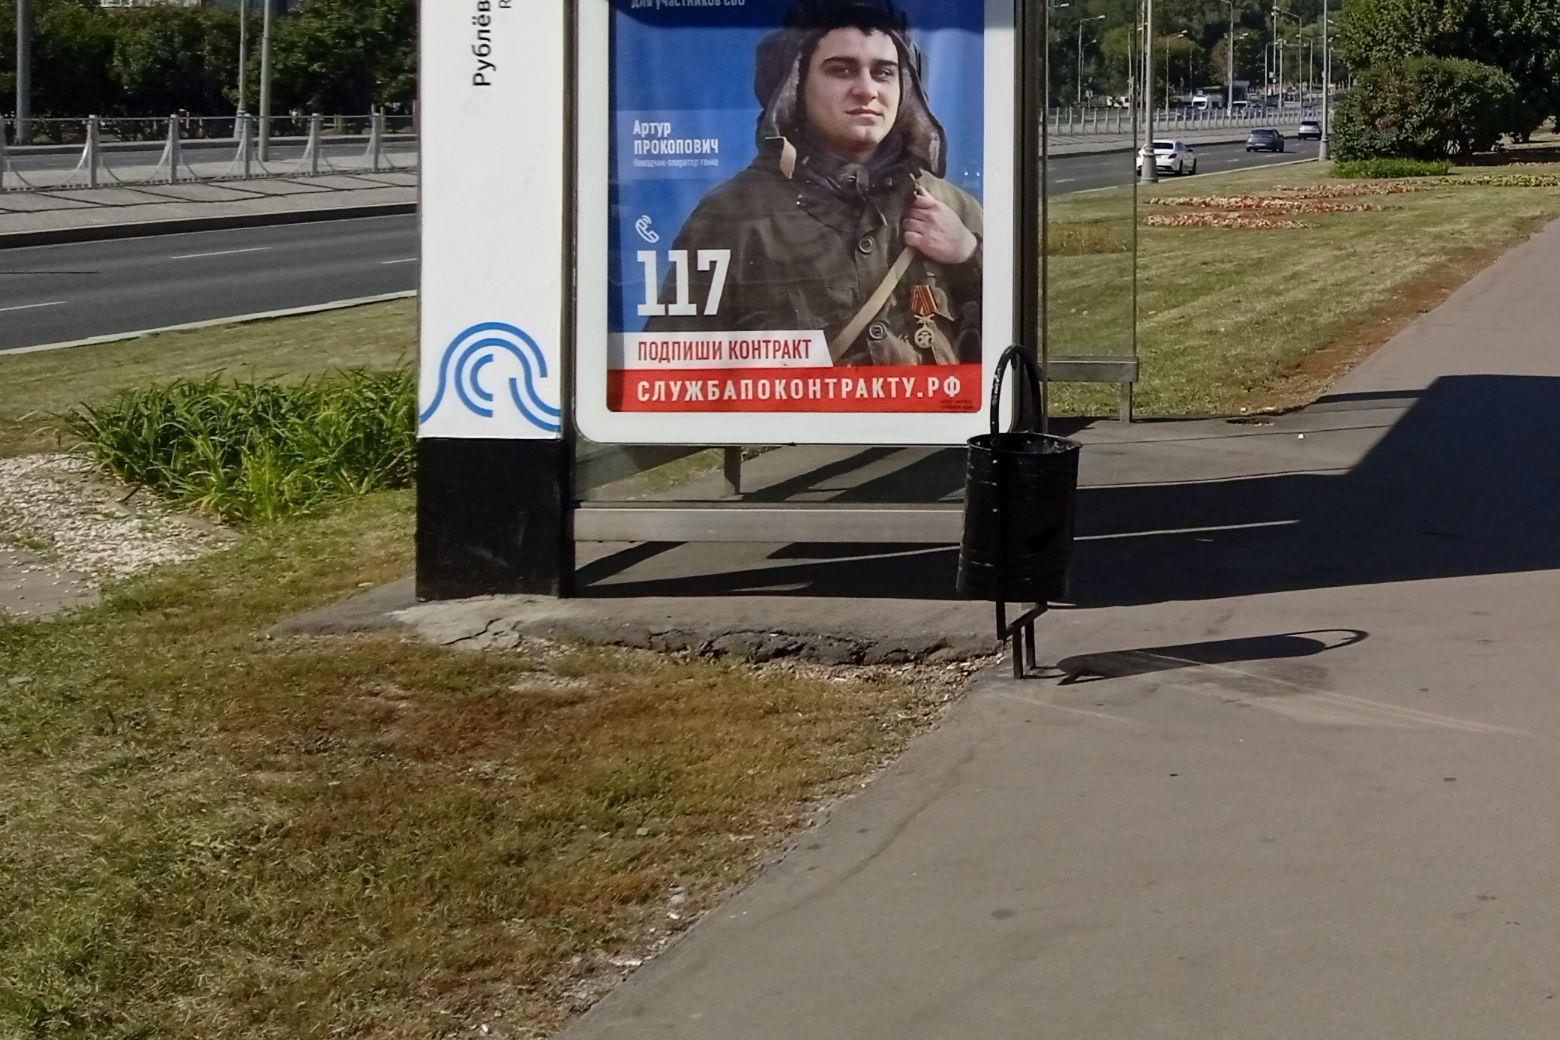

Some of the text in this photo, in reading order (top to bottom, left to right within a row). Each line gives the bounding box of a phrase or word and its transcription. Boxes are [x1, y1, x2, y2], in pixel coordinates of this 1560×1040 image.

[633, 120, 671, 138] Артур
[634, 139, 719, 154] ПРОКОПОВИЧ
[636, 249, 731, 317] 117
[637, 338, 812, 364] ПОДПИШИ КОНТРАКТ
[636, 376, 962, 403] СЛУЖБАПОКОНТРАКТУ.РФ
